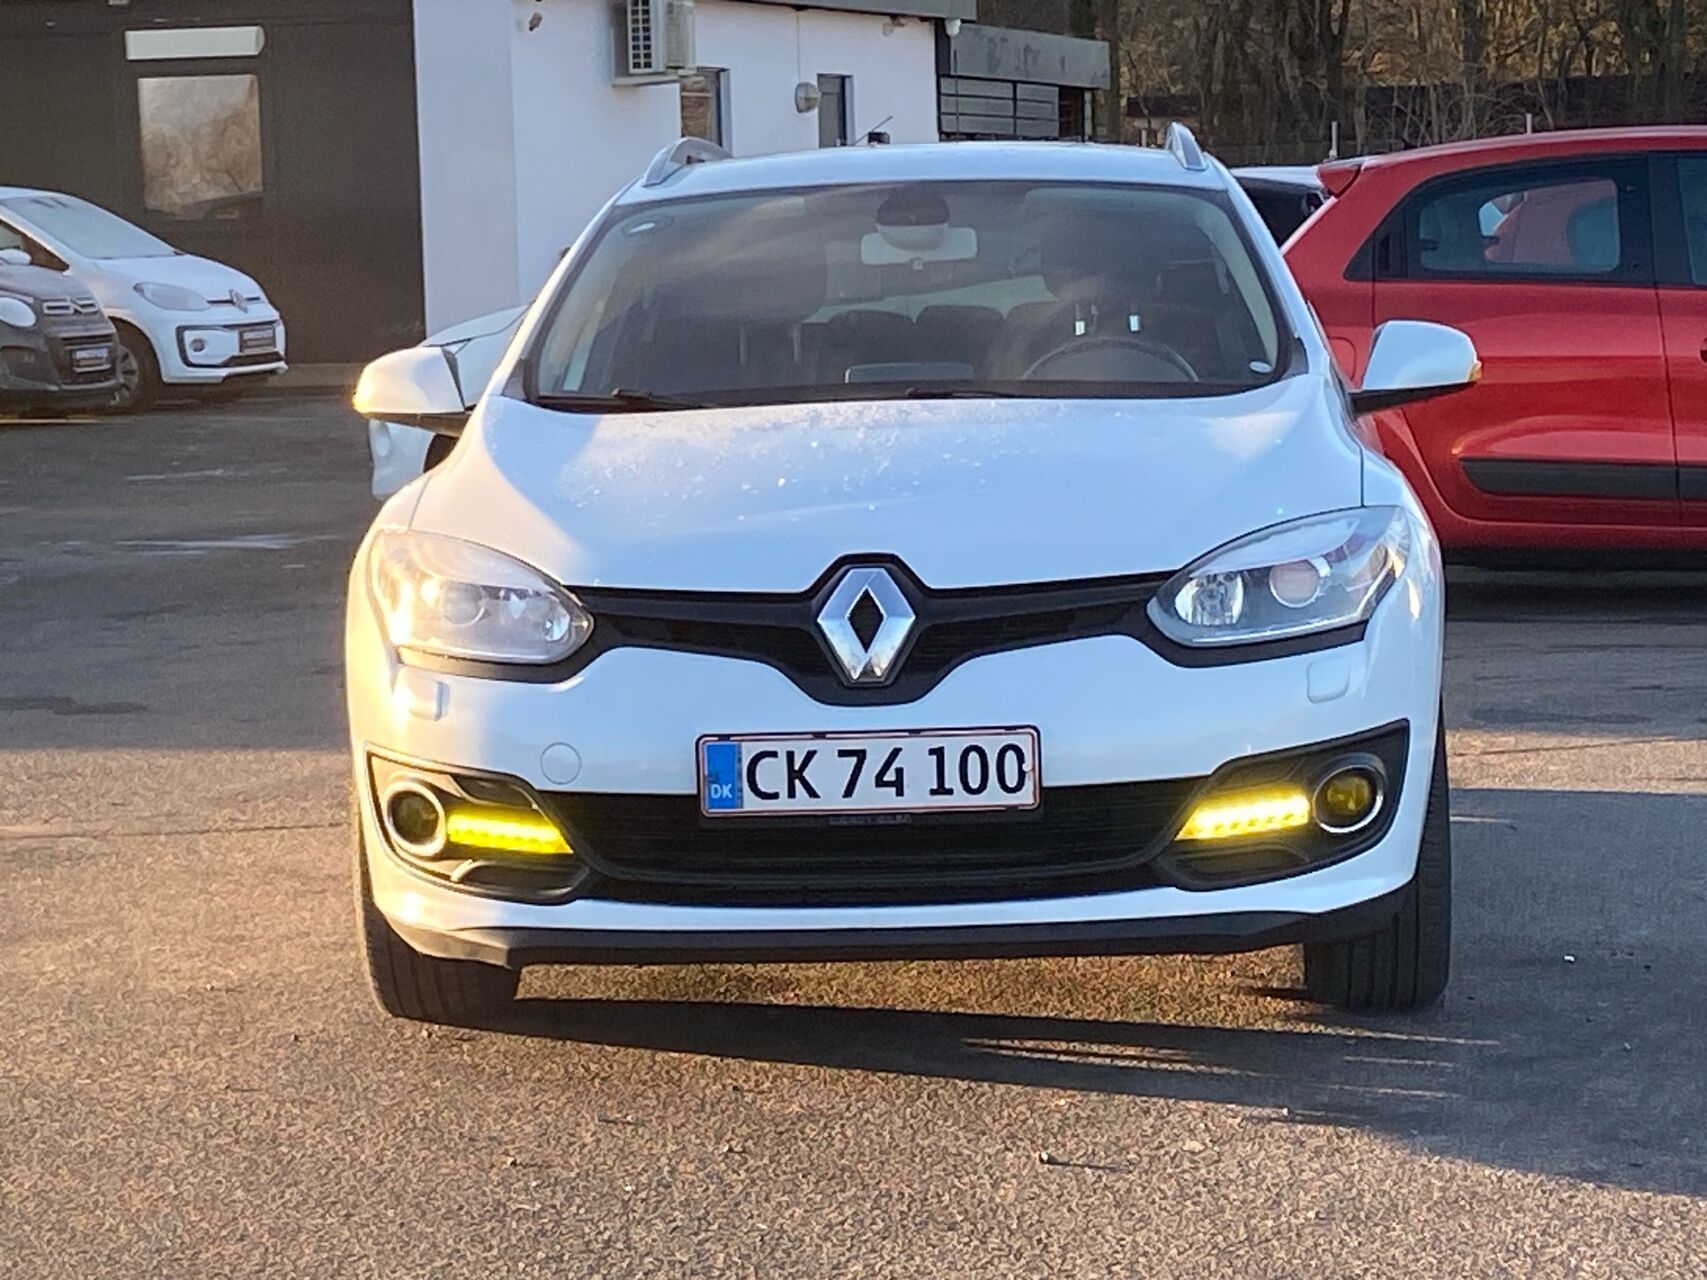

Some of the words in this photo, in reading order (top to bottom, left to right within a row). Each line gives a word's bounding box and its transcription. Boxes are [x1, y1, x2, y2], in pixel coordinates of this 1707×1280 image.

[746, 749, 821, 800] CK
[837, 747, 905, 799] 74
[928, 744, 1026, 796] 100
[711, 784, 733, 798] DK
